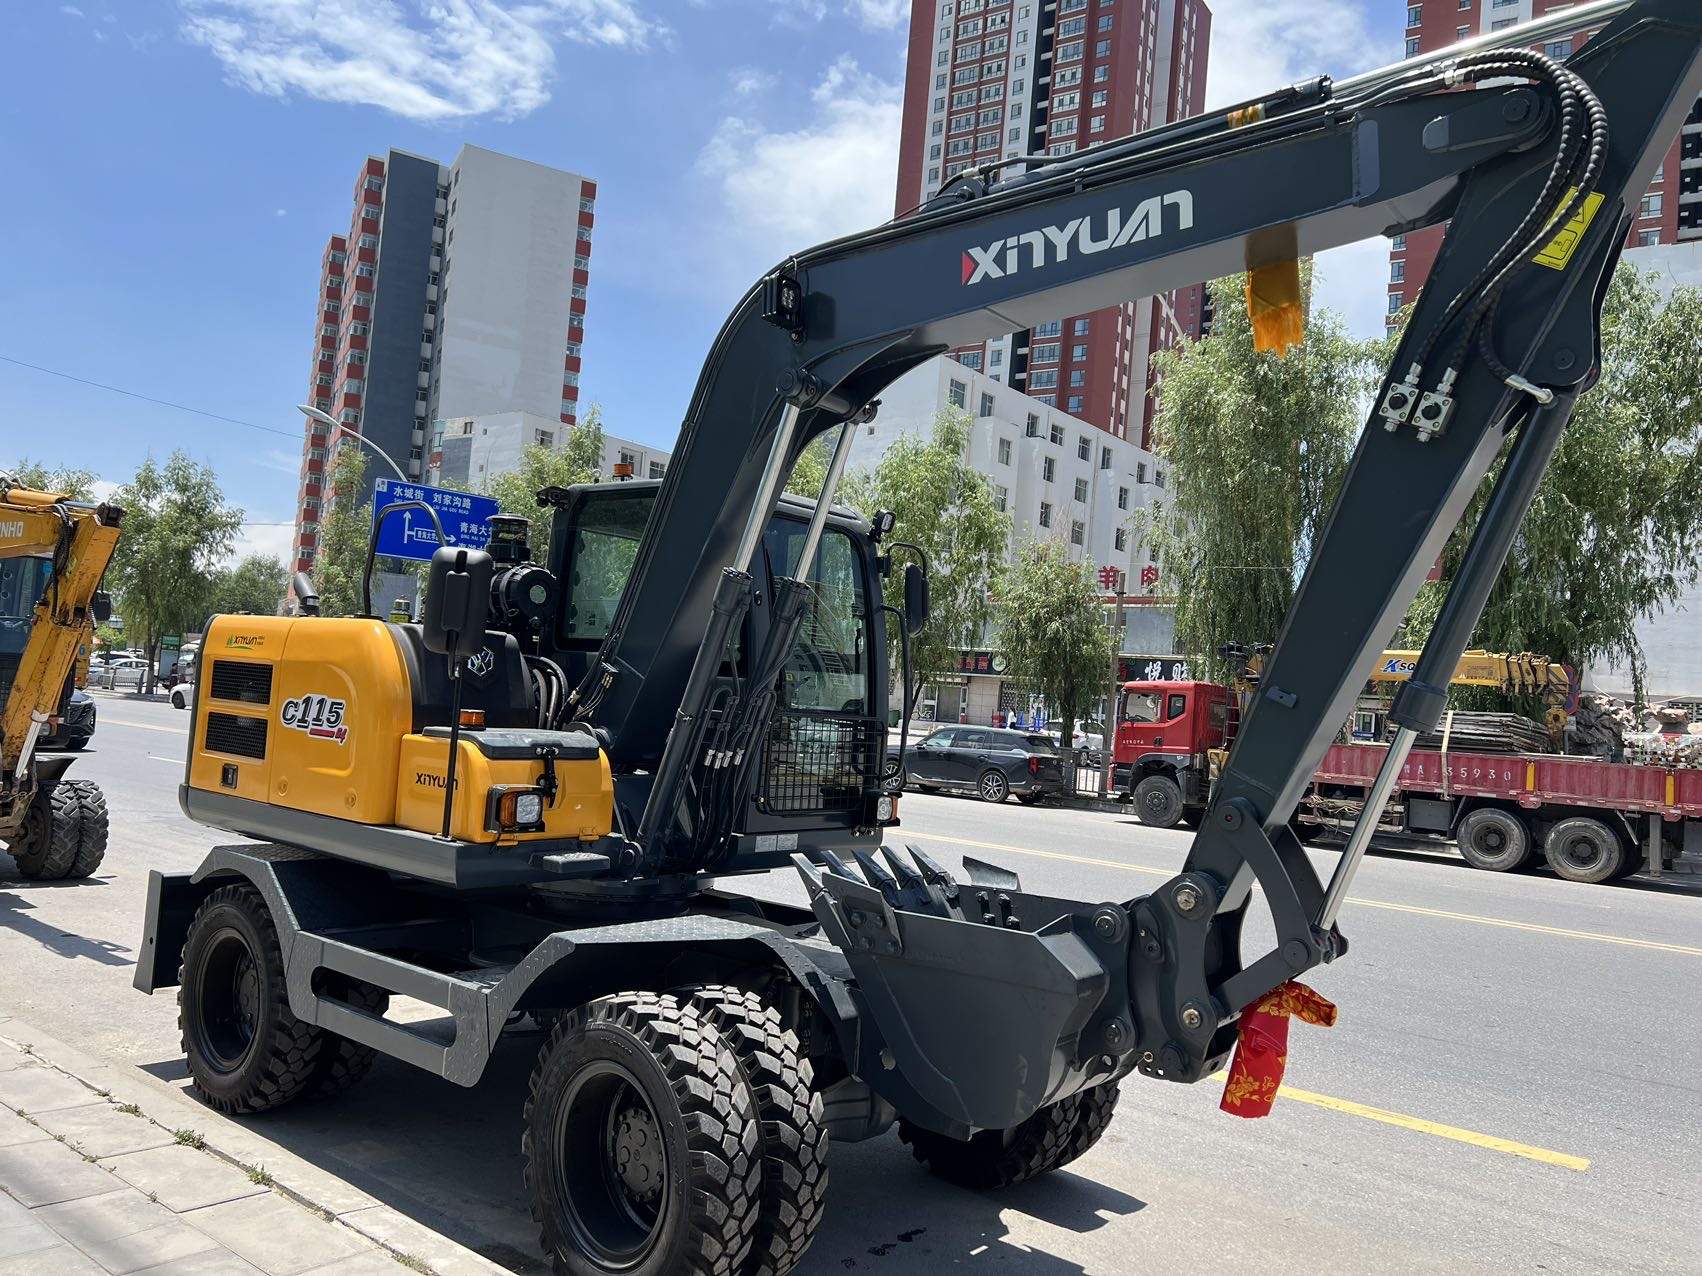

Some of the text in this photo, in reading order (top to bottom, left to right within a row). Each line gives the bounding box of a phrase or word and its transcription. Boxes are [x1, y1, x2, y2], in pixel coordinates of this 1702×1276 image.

[433, 492, 471, 509] 刘家沟路
[417, 531, 438, 541] 青海大学
